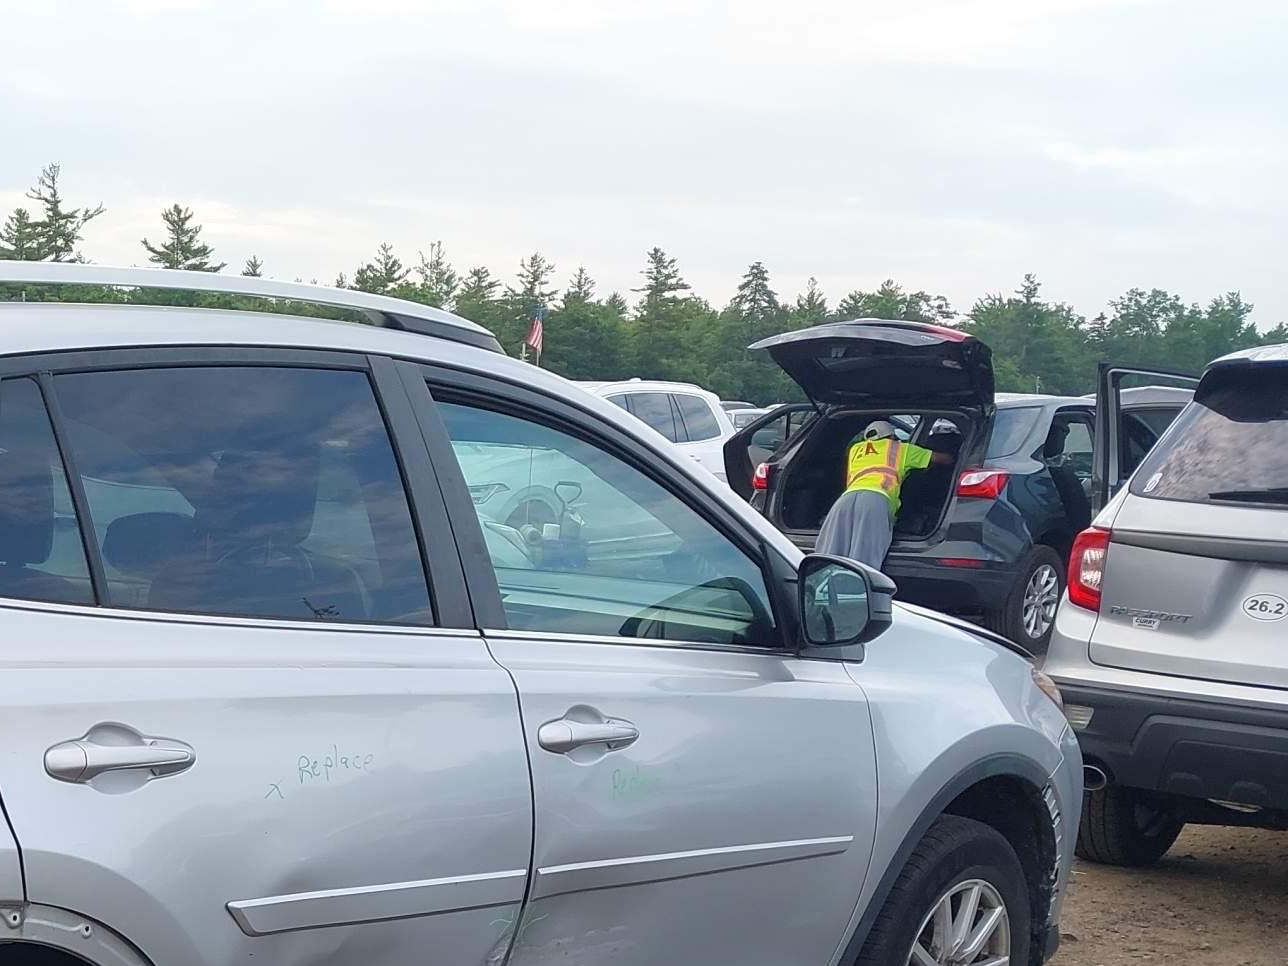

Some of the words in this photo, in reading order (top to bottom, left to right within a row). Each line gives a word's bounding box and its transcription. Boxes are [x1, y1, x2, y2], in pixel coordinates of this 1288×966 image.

[1110, 605, 1194, 623] PASSPORT
[1247, 599, 1285, 614] 26.2
[297, 743, 374, 784] Replace
